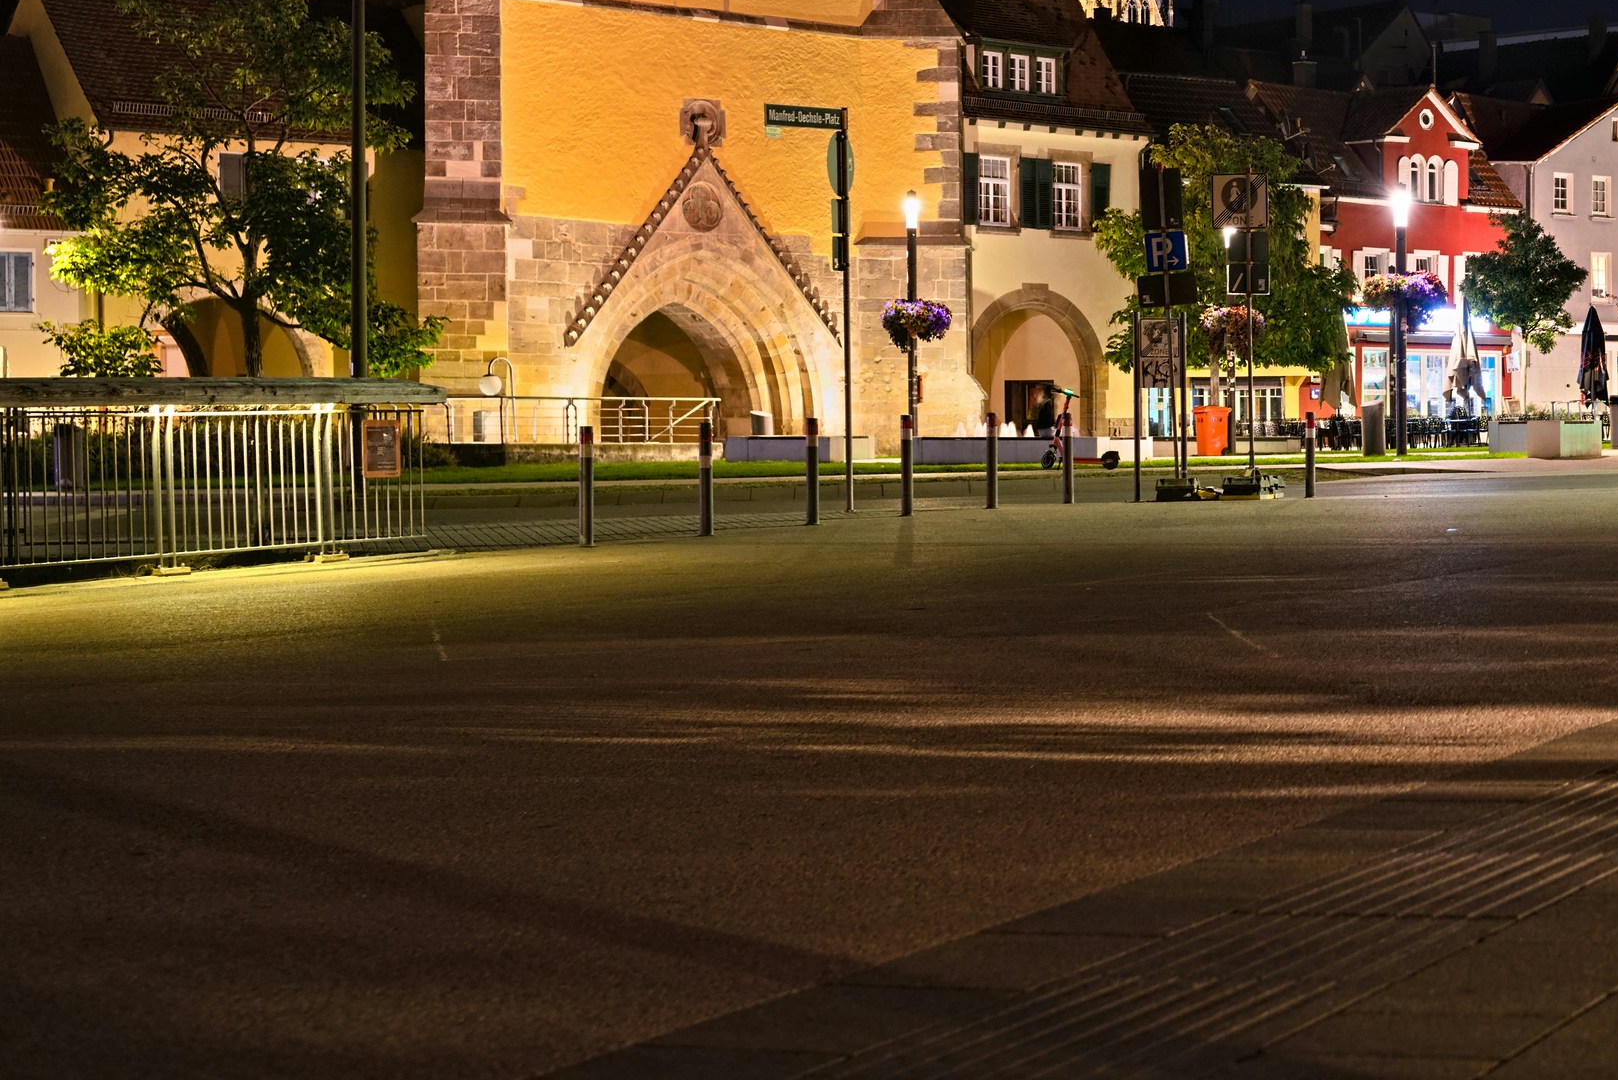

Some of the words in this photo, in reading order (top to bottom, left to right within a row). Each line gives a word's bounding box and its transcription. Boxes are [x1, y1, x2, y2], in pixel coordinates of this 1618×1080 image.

[768, 109, 841, 125] Manfred-Oechsle-Platz
[1226, 215, 1254, 226] ZONE
[1151, 237, 1173, 268] P
[1150, 348, 1170, 356] ZONE
